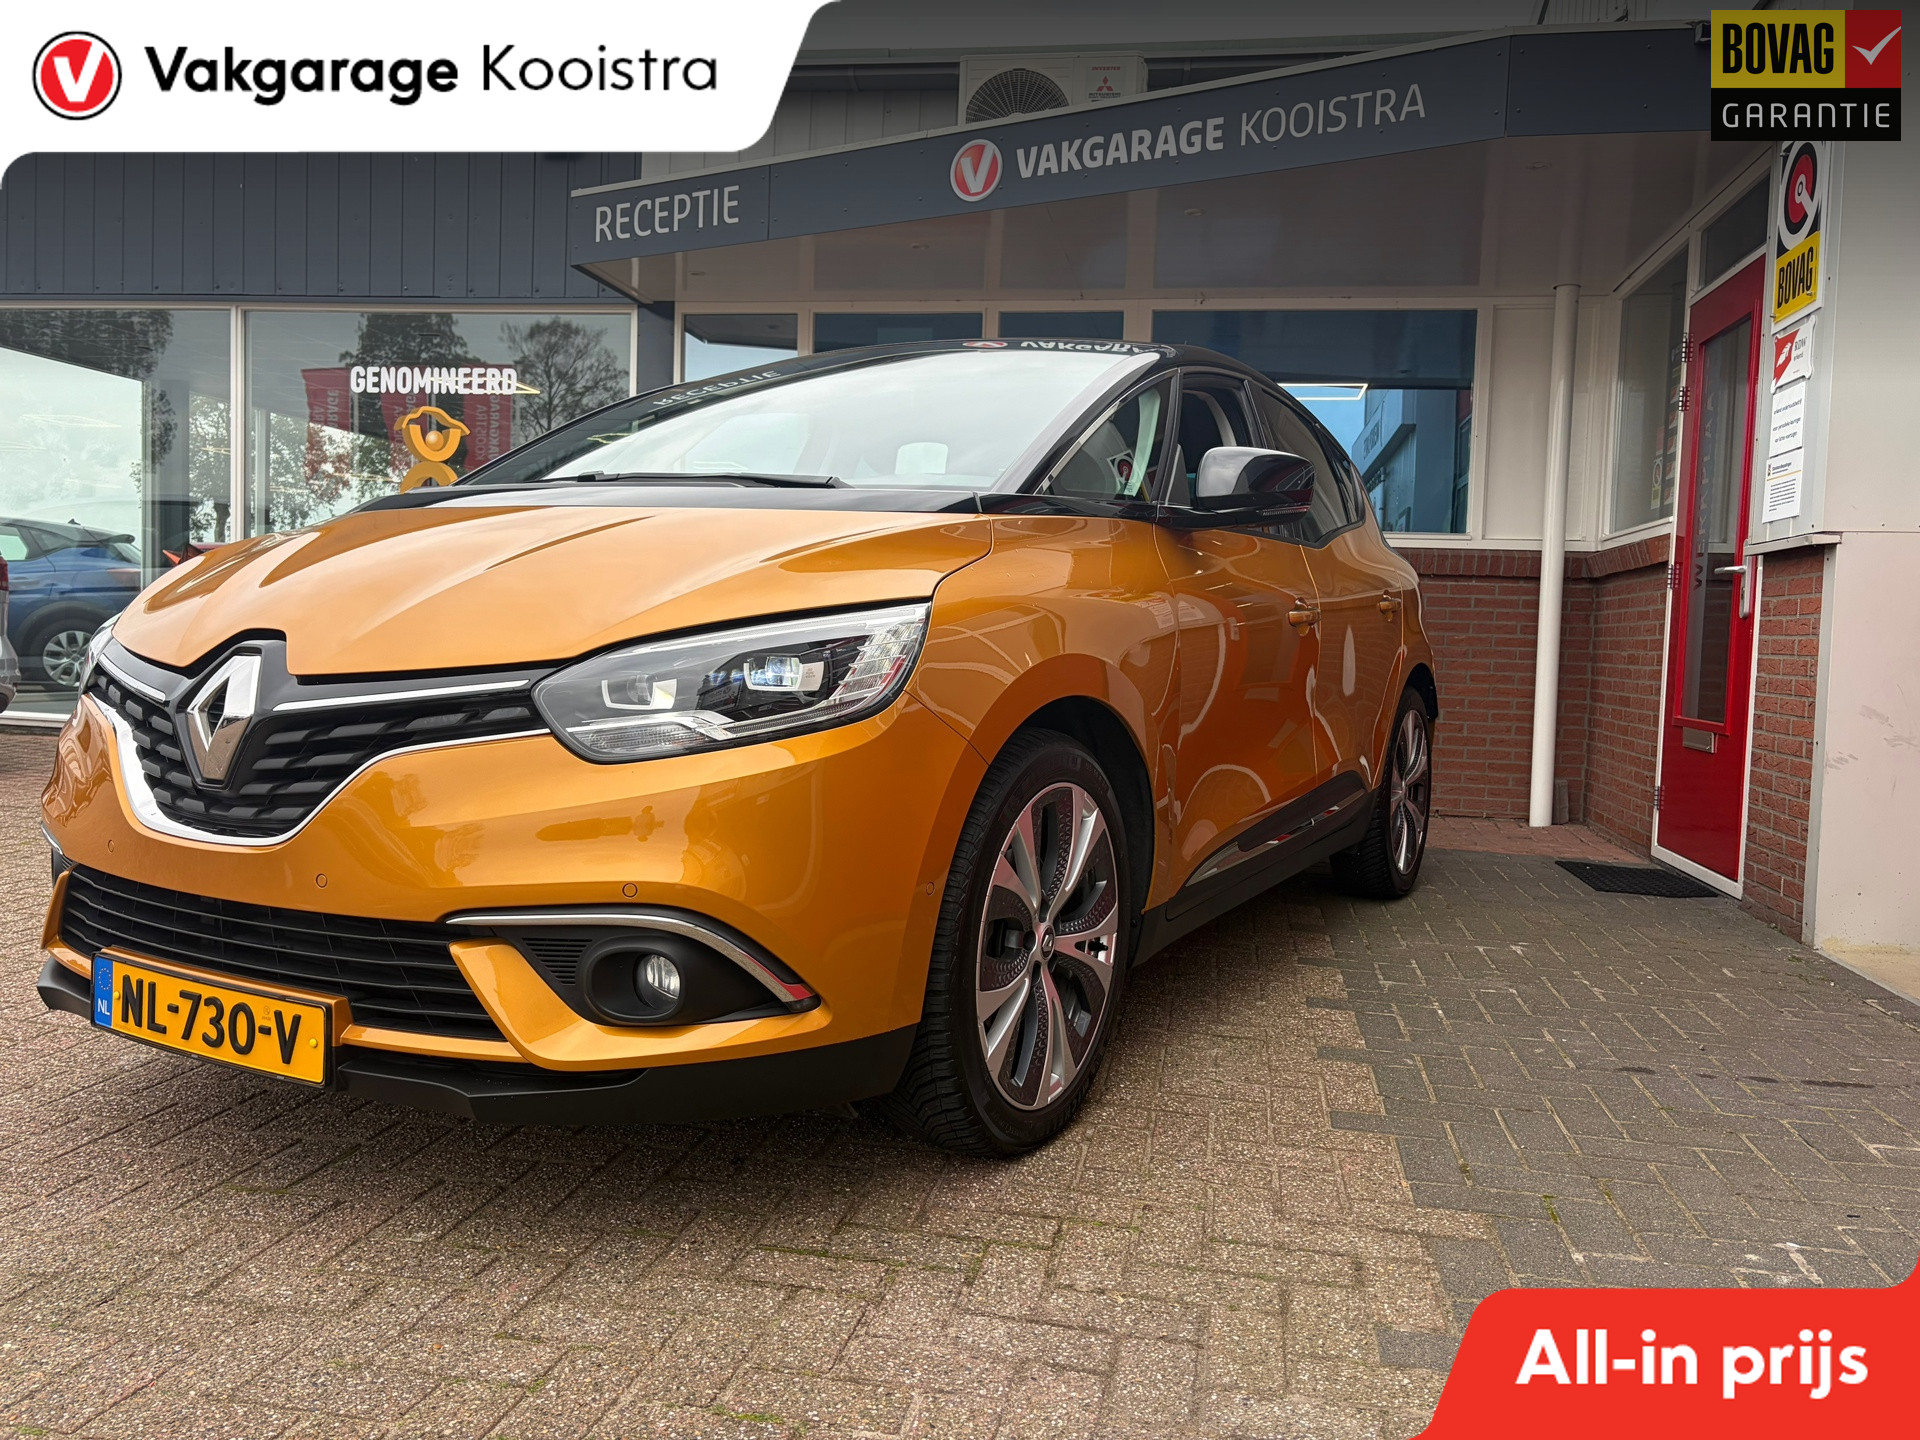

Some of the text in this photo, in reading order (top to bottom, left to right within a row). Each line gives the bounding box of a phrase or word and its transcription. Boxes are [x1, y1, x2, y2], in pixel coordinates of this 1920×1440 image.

[1016, 83, 1427, 179] VAKGARAGE KOOISTRA
[595, 185, 740, 243] RECEPTIE
[1776, 246, 1814, 309] BOVAG
[350, 365, 518, 395] GENOMINEERD
[97, 997, 110, 1016] NL
[120, 974, 302, 1065] NL-730-V
